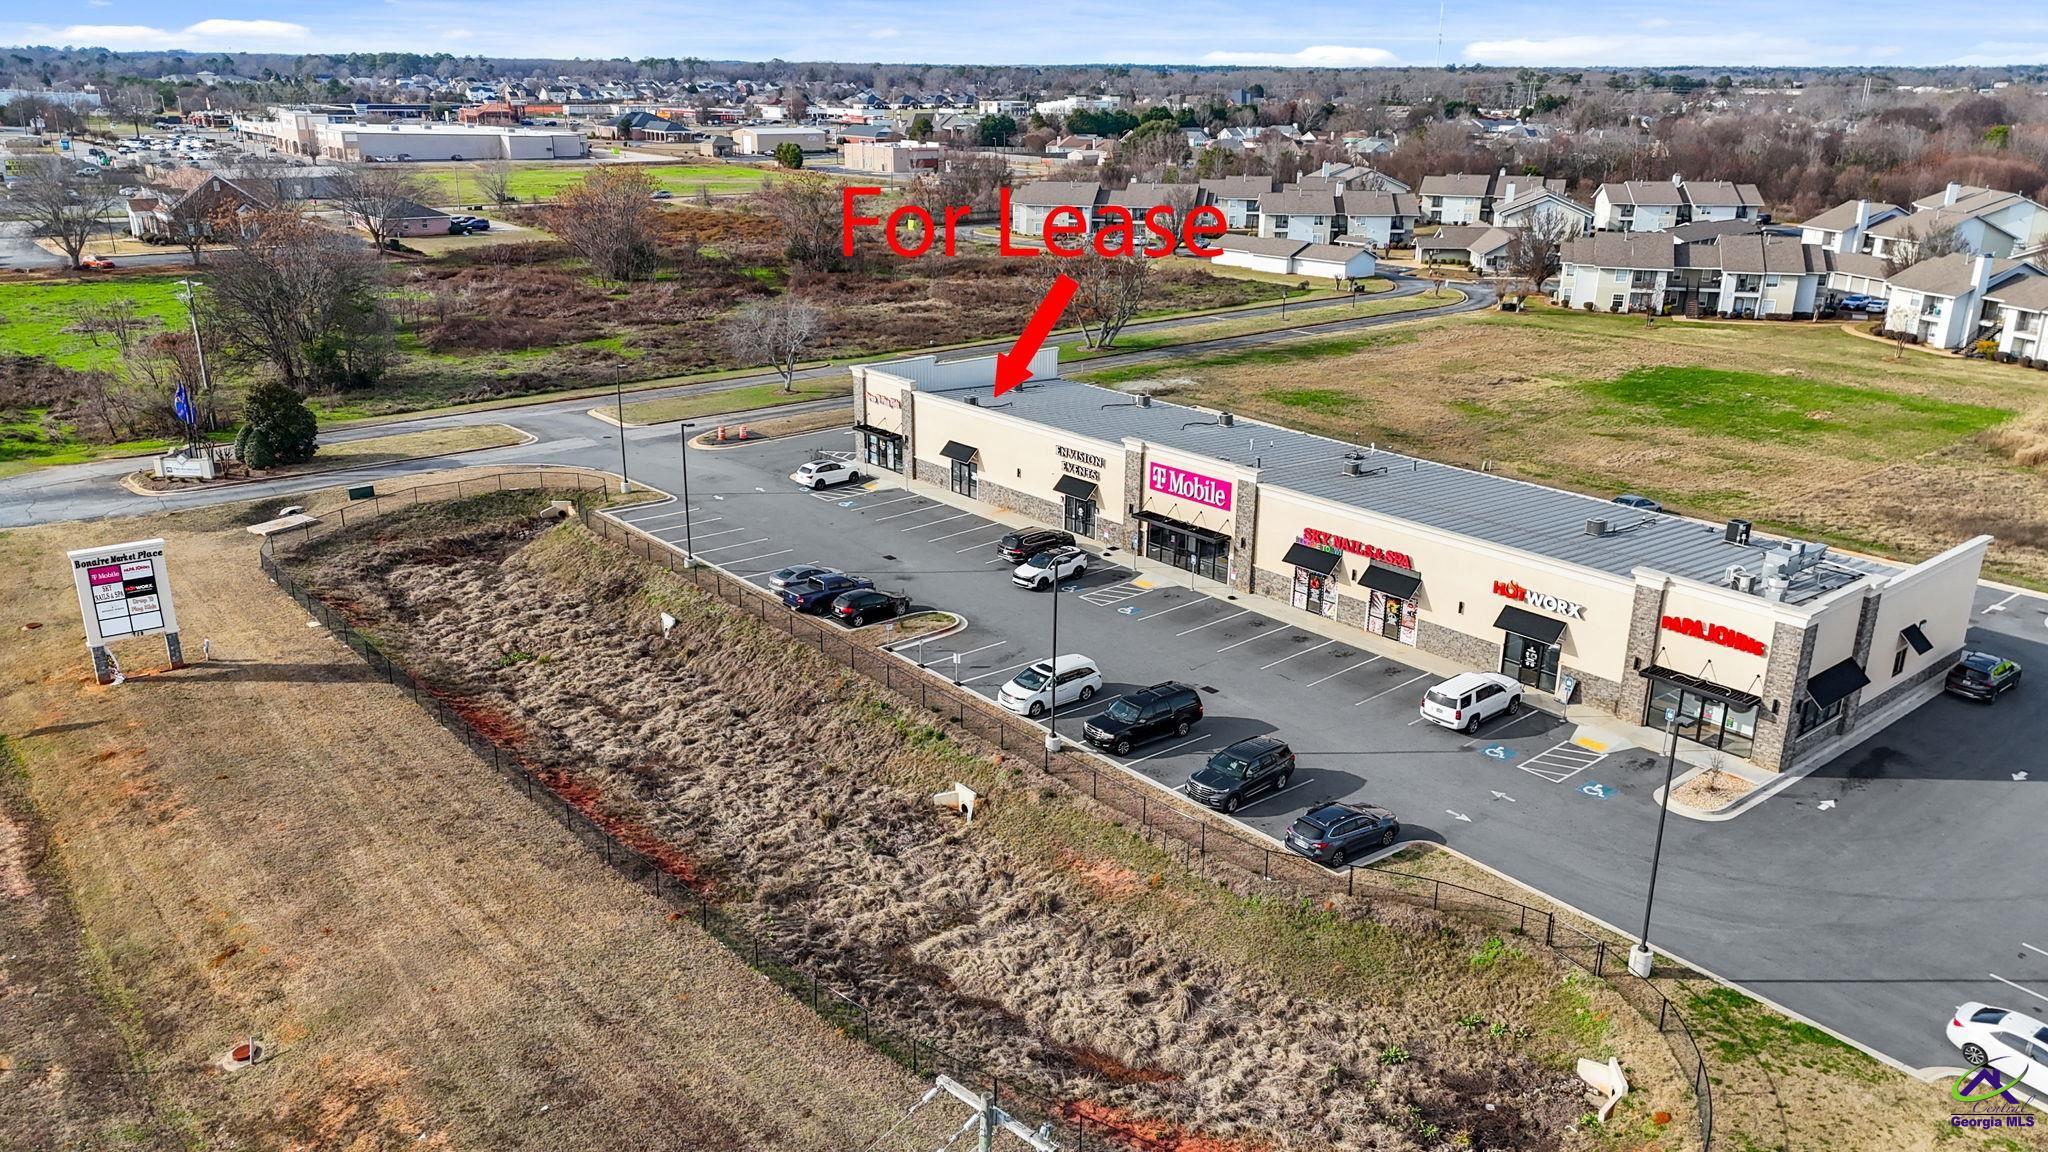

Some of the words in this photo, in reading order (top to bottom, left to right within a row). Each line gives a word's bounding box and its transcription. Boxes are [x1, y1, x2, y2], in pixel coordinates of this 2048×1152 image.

[1056, 445, 1105, 468] ENVISION
[1061, 461, 1099, 481] EVENTS
[1169, 471, 1225, 506] Mobile
[75, 557, 109, 568] Bonaire
[110, 554, 136, 562] Market
[138, 550, 162, 559] Place
[1303, 527, 1332, 545] SKY
[1332, 535, 1374, 558] NAILS
[1373, 548, 1385, 560] &
[1385, 550, 1412, 569] SPA
[98, 571, 120, 580] Mobile
[101, 584, 112, 592] SKY
[1493, 580, 1582, 619] HOTWORX
[1662, 616, 1704, 640] PAPA
